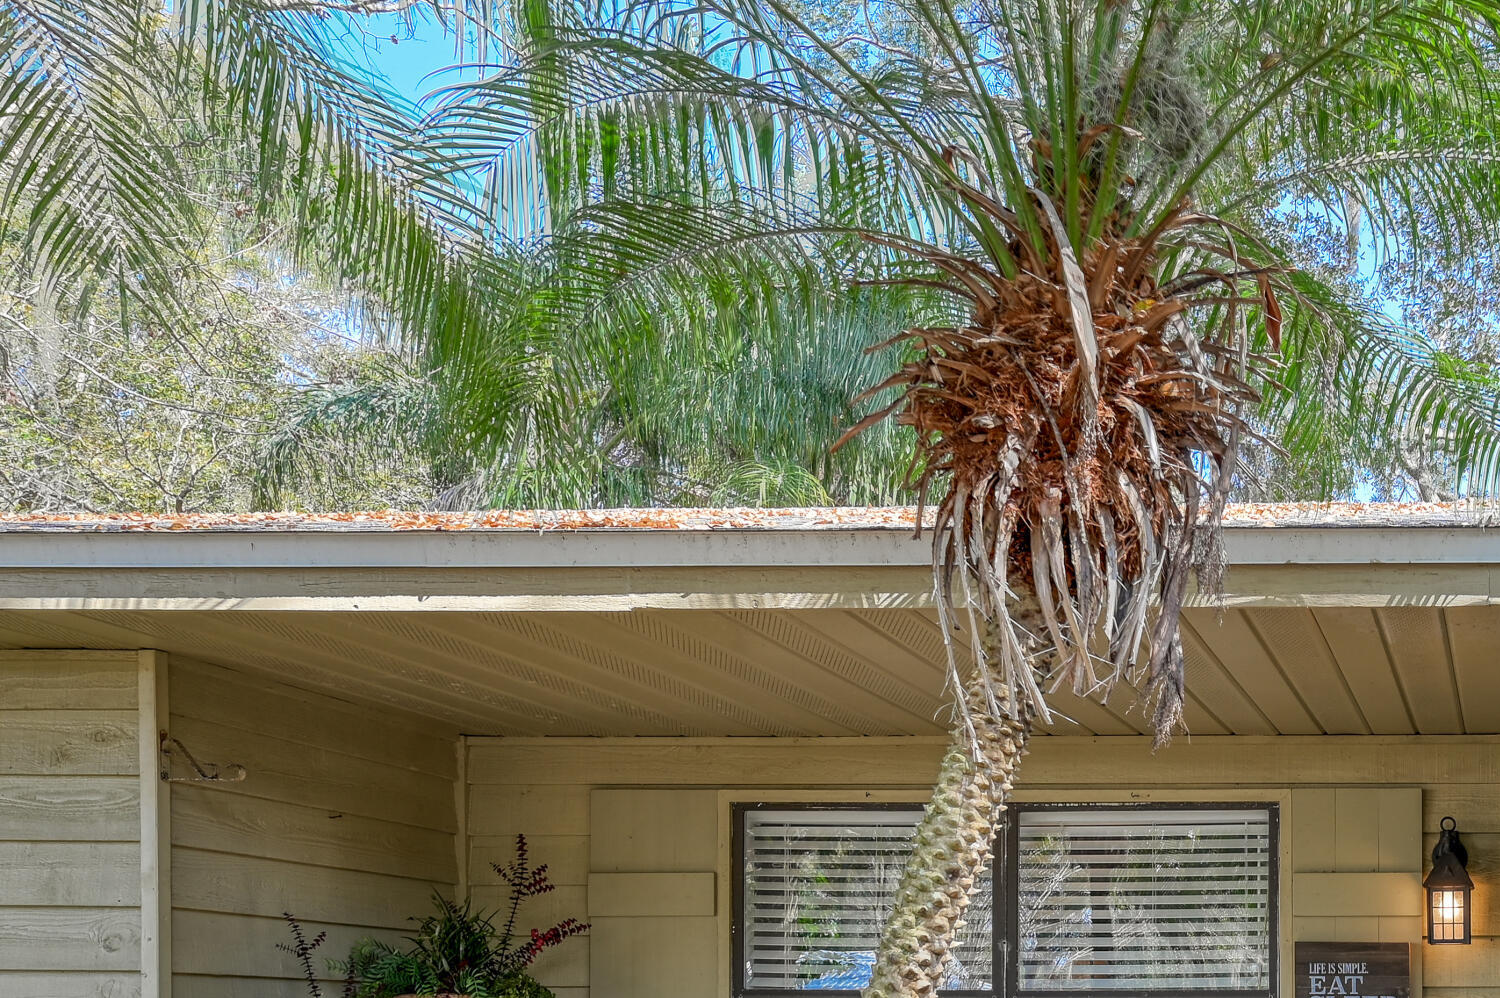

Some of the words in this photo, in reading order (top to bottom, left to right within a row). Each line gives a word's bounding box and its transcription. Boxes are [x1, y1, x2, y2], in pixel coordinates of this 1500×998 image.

[1309, 962, 1327, 974] LIFE
[1328, 962, 1336, 974] IS
[1337, 962, 1369, 974] SIMPLE.
[1309, 975, 1364, 995] EAT
